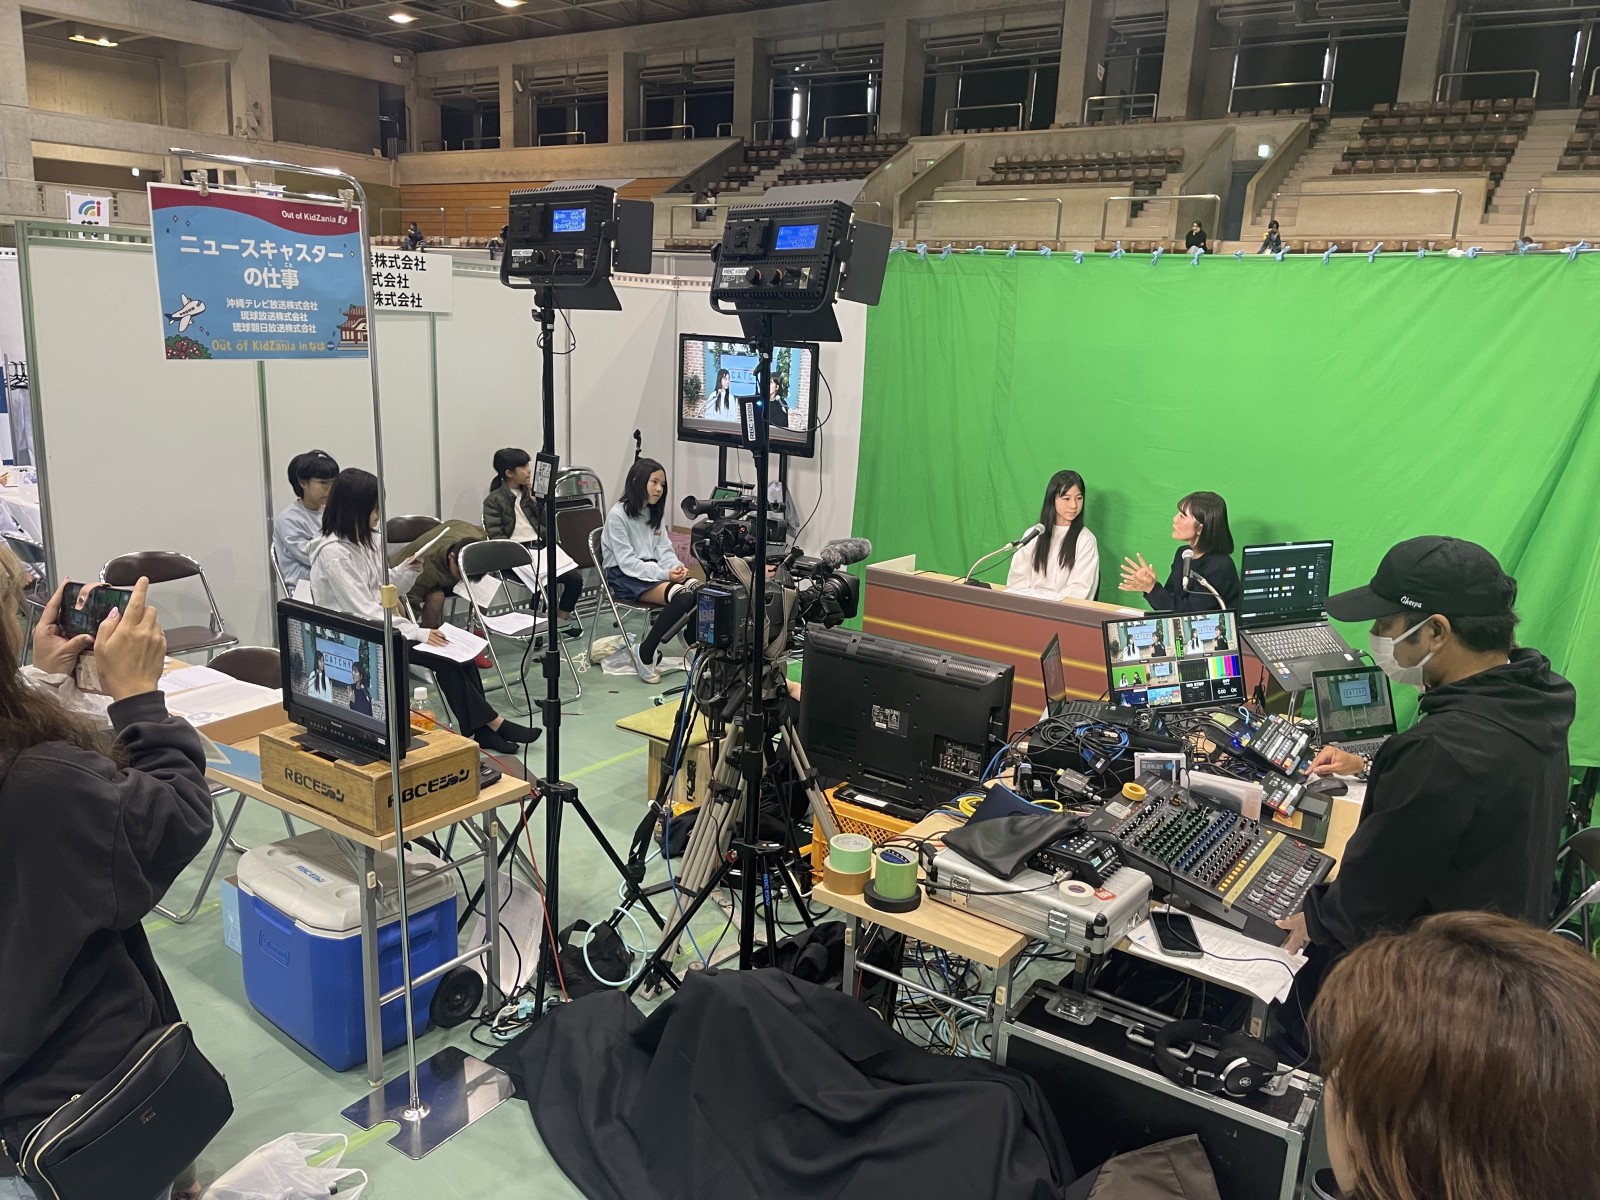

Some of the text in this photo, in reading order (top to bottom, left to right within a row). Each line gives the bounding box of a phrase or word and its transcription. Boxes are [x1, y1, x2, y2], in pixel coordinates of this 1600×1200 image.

[282, 211, 295, 219] Out
[295, 211, 303, 219] of
[303, 212, 337, 223] KidZania
[180, 235, 344, 263] ニュースキャスター
[243, 267, 300, 290] の仕事
[226, 298, 318, 311] 沖縄テレビ放送株式会社
[240, 310, 308, 322] 琉球放送株式会社
[232, 322, 317, 334] 琉球朝日放送株式会社
[212, 339, 232, 351] Out
[236, 339, 249, 351] of
[253, 339, 296, 351] KidZania
[746, 403, 756, 440] RBC VISION
[324, 653, 353, 670] CATCHY
